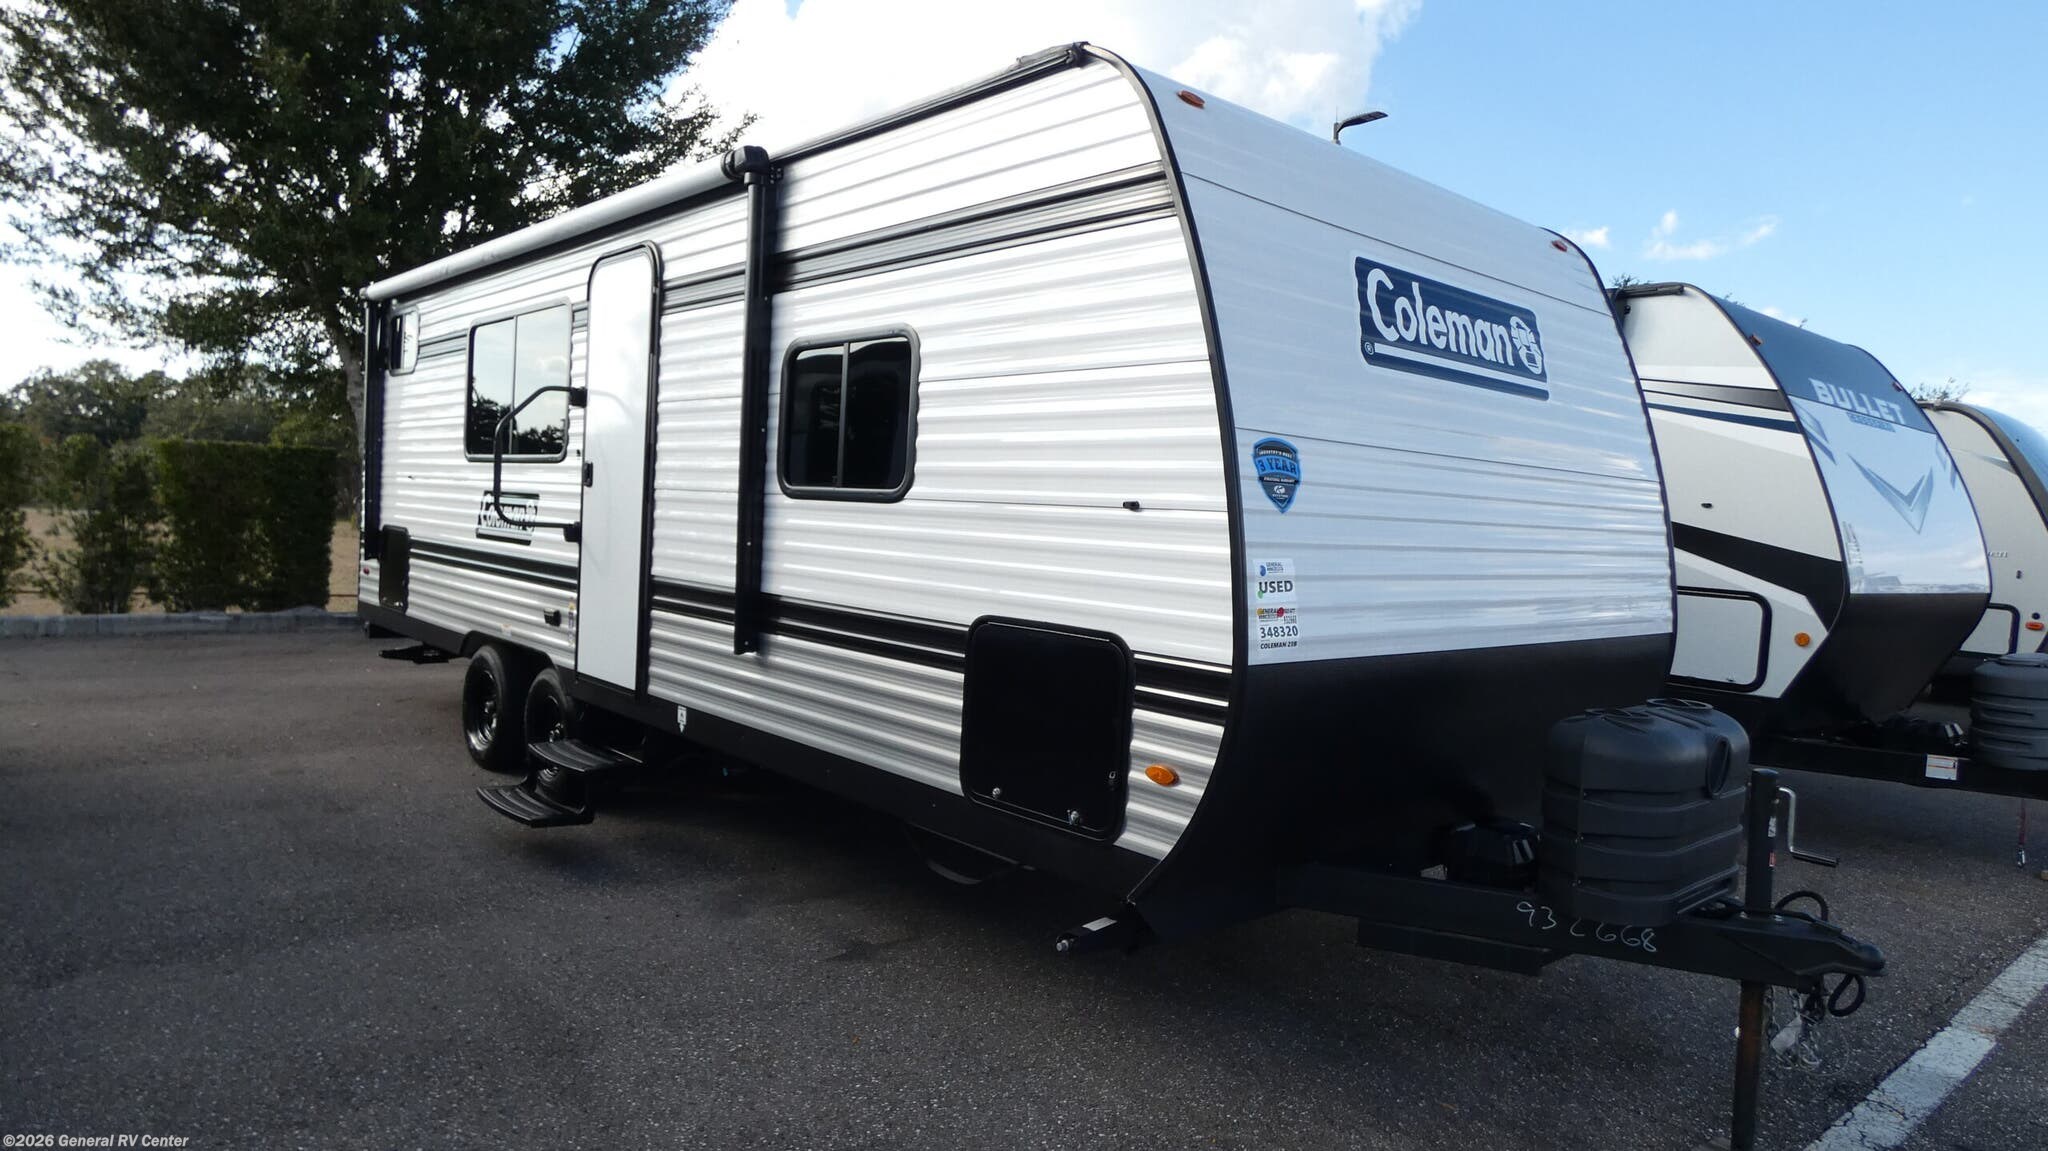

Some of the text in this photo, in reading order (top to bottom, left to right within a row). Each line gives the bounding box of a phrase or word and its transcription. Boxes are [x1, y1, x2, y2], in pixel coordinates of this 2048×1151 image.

[1367, 268, 1515, 367] Coleman
[1808, 378, 1906, 425] BULLET
[1257, 457, 1298, 475] 3 YEAR
[1259, 580, 1294, 594] USED
[1259, 625, 1299, 639] 348320
[1260, 641, 1287, 650] COLEMAN
